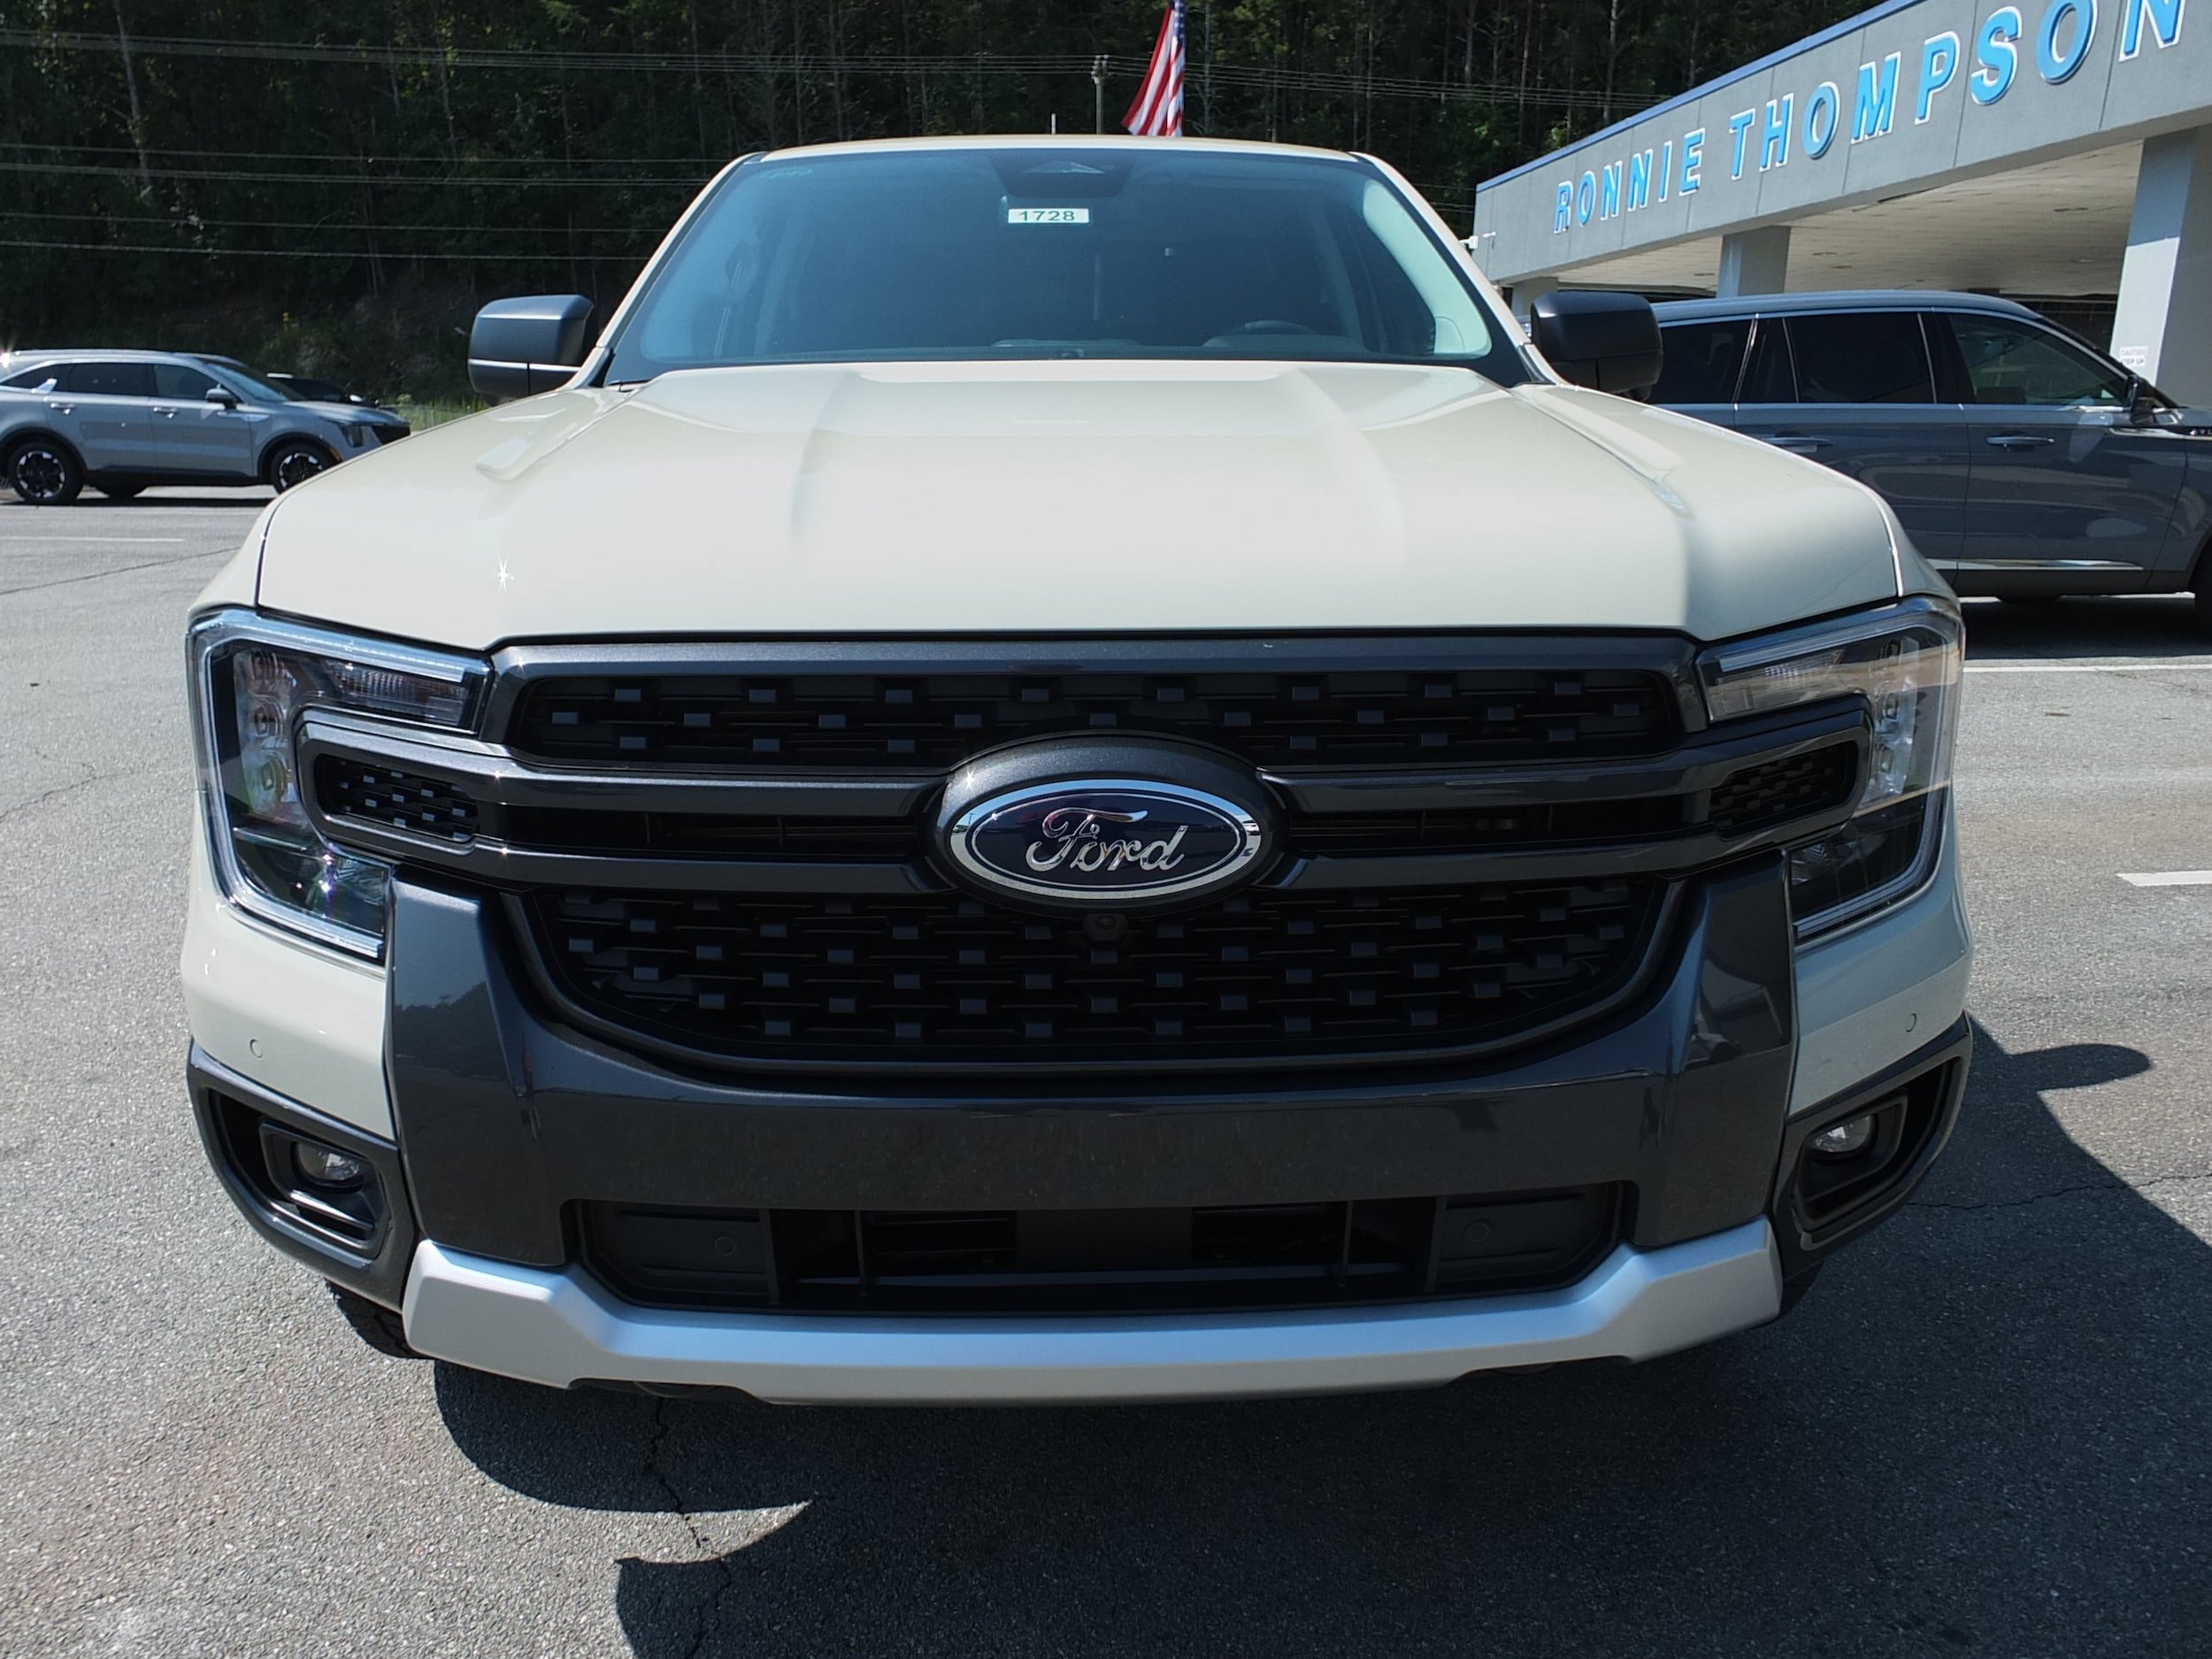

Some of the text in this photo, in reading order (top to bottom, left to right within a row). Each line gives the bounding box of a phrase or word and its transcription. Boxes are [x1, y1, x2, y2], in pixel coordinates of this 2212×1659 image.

[1554, 0, 2185, 234] RONNIE THOMPSON
[1019, 211, 1075, 221] 1728
[1025, 807, 1188, 872] Ford
